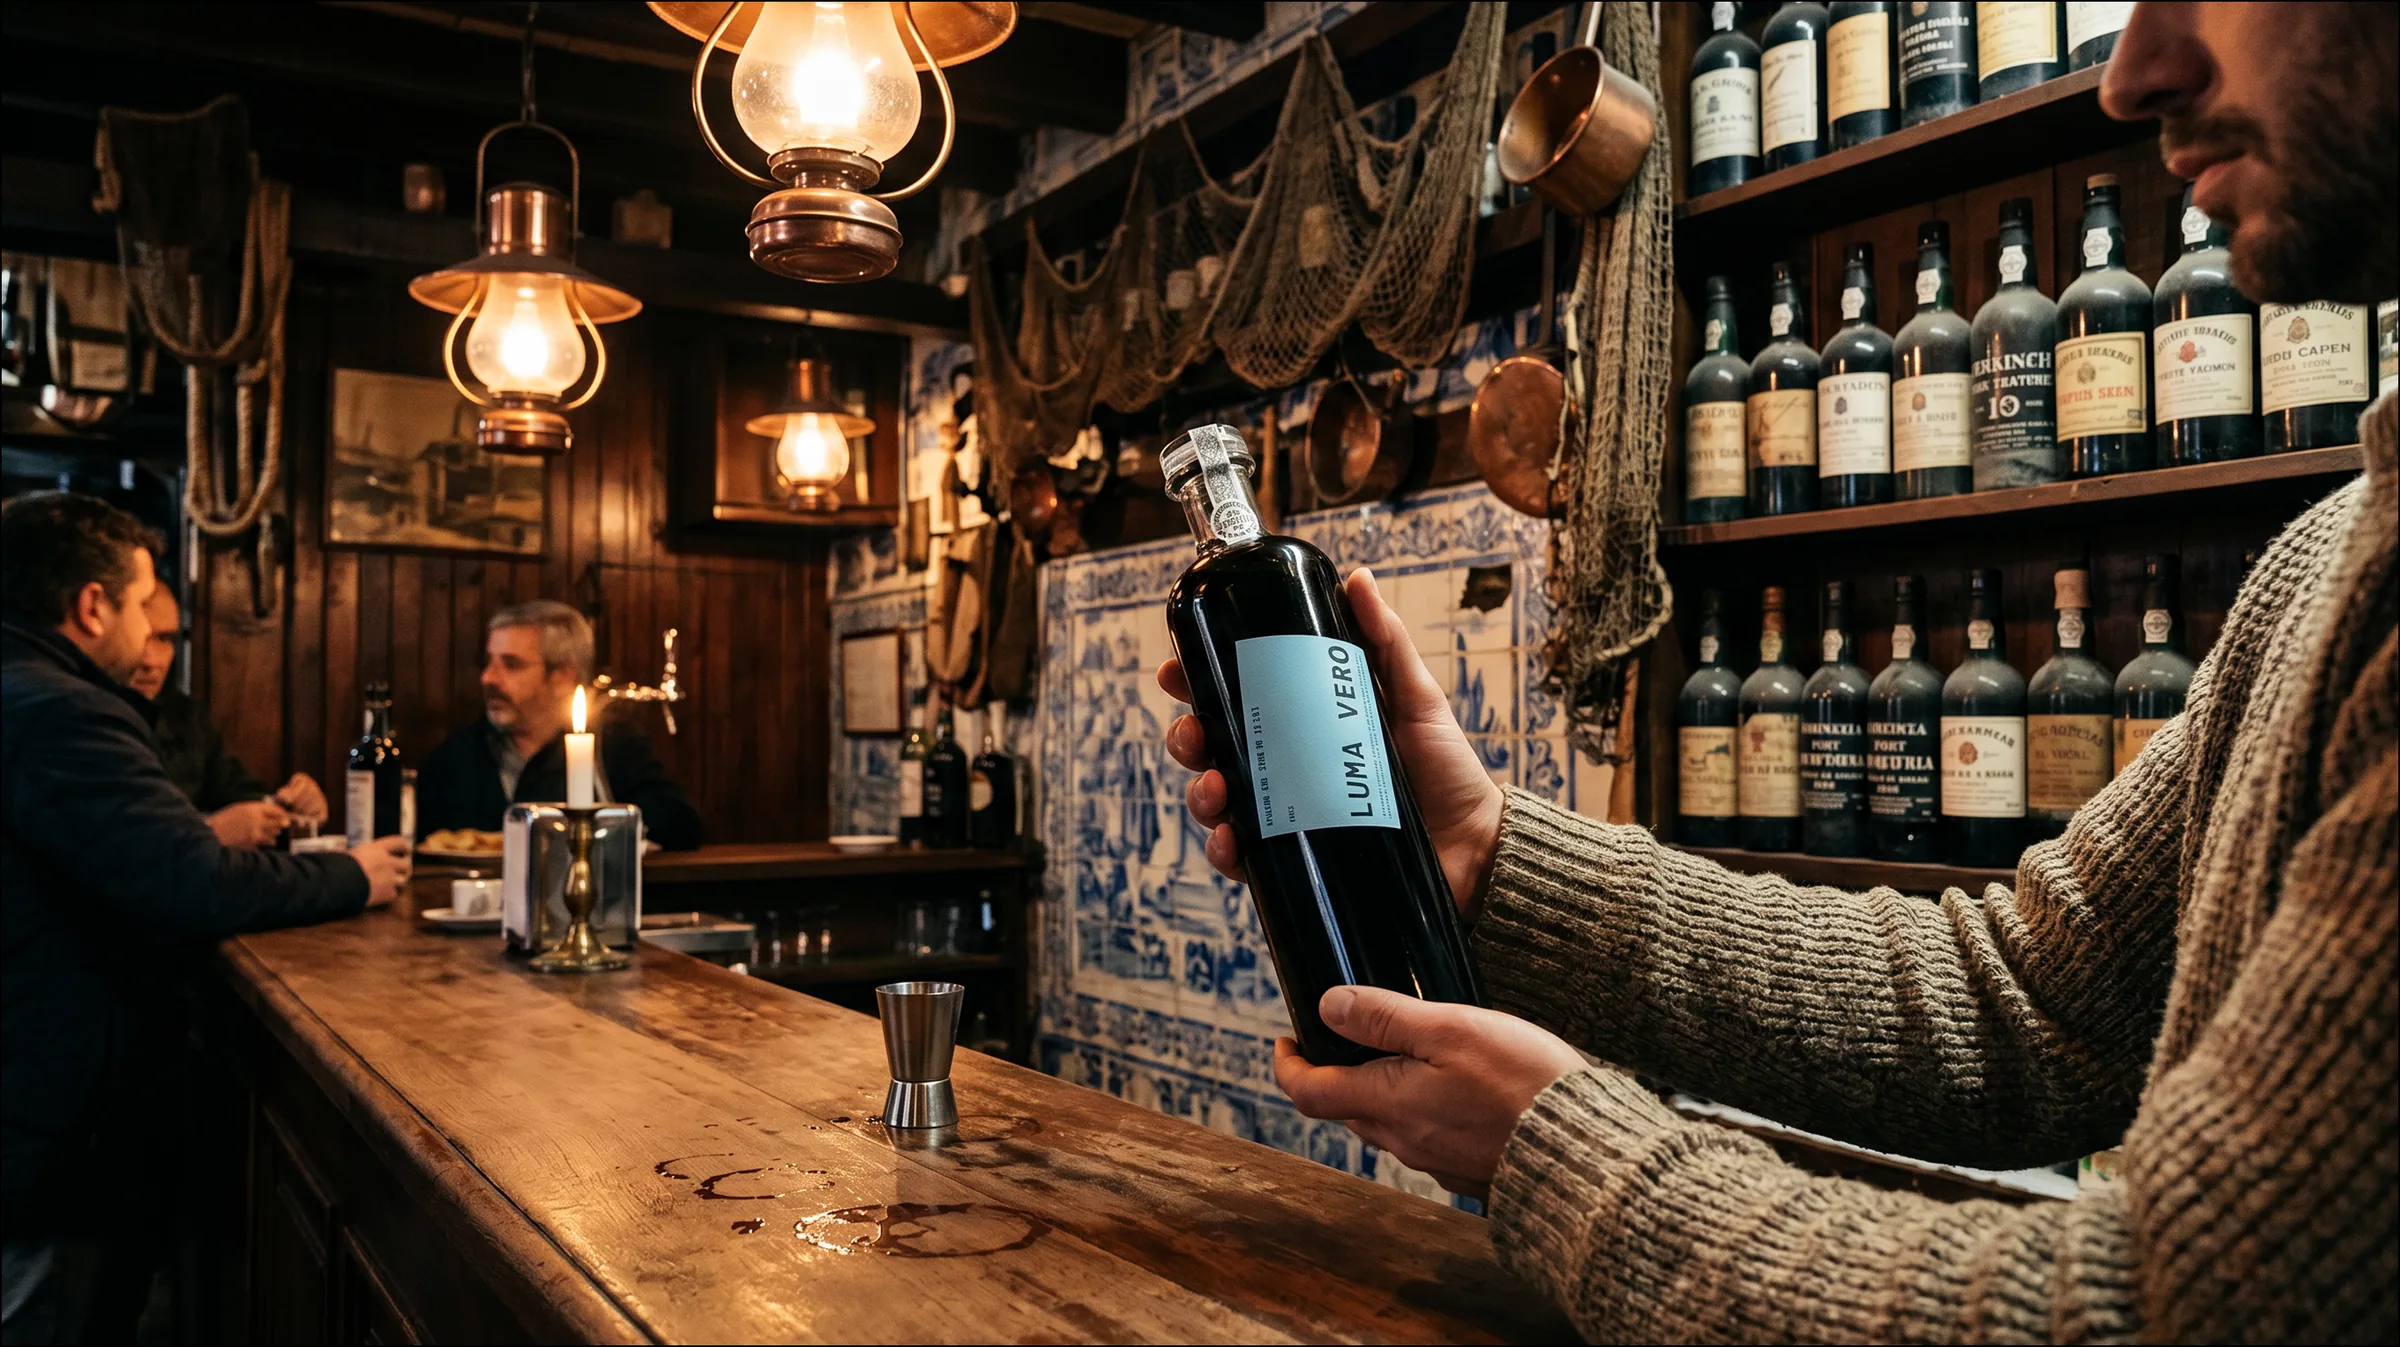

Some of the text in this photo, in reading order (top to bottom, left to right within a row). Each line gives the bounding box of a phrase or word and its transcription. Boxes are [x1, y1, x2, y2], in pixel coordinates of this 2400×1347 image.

[2298, 342, 2351, 357] CAPEN
[1328, 645, 1358, 720] VERO
[1342, 742, 1374, 818] LUMA
